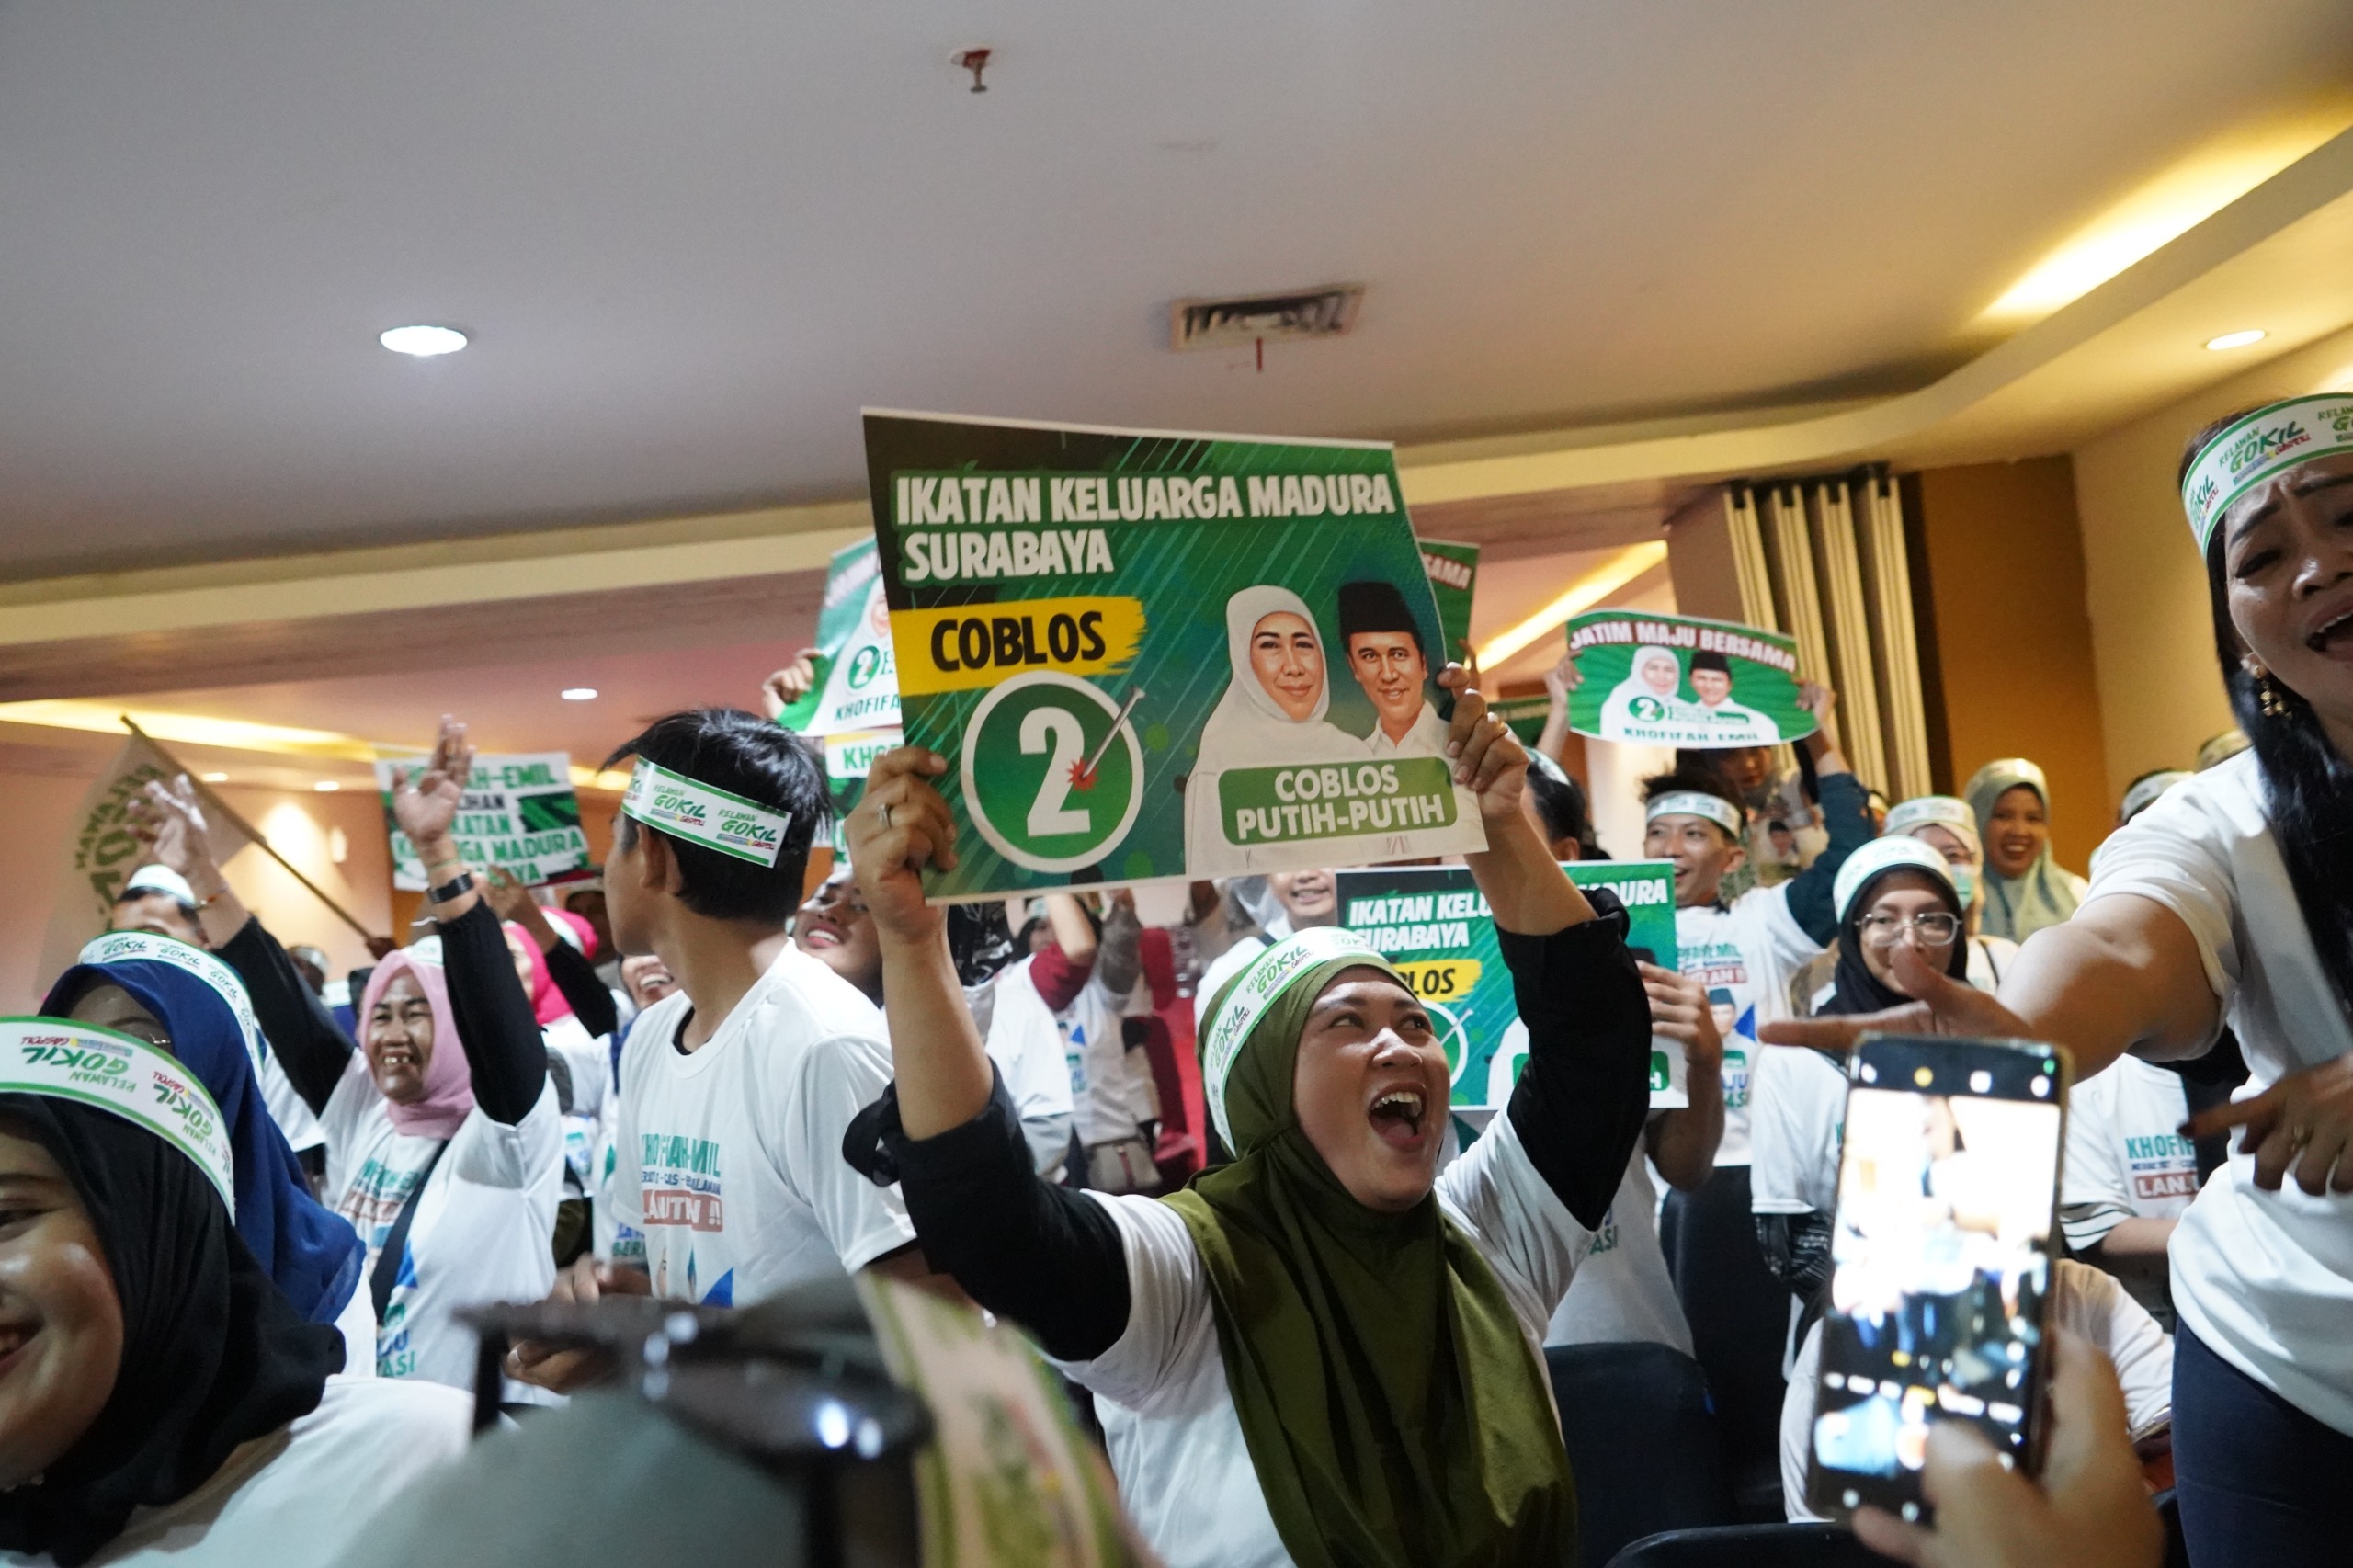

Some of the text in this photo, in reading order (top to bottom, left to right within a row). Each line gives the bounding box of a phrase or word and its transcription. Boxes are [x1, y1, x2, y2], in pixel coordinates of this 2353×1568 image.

[2229, 420, 2305, 474] GOKIL
[897, 473, 1396, 525] IKATAN KELUARGA MADURA
[904, 528, 1115, 581] SURABAYA
[930, 610, 1107, 673] COBLOS
[1570, 620, 1797, 674] JATIM MAJU BERSAMA
[835, 693, 901, 722] KHOFIFA
[1636, 698, 1657, 722] 2
[1019, 706, 1091, 838] 2
[1274, 764, 1399, 802] COBLOS
[654, 794, 707, 819] GOKIL
[1236, 793, 1446, 840] PUTIH-PUTIH
[492, 830, 583, 861] MADURA
[721, 819, 777, 843] GOKIL
[1349, 895, 1433, 926] IKATAN
[1437, 892, 1494, 920] KELU
[160, 947, 201, 966] GOKIL
[1257, 945, 1308, 994] GOKIL
[1215, 1005, 1245, 1068] GOKIL
[21, 1045, 130, 1075] GOKIL
[69, 1071, 137, 1093] RELAWAN
[153, 1083, 213, 1138] GOKIL
